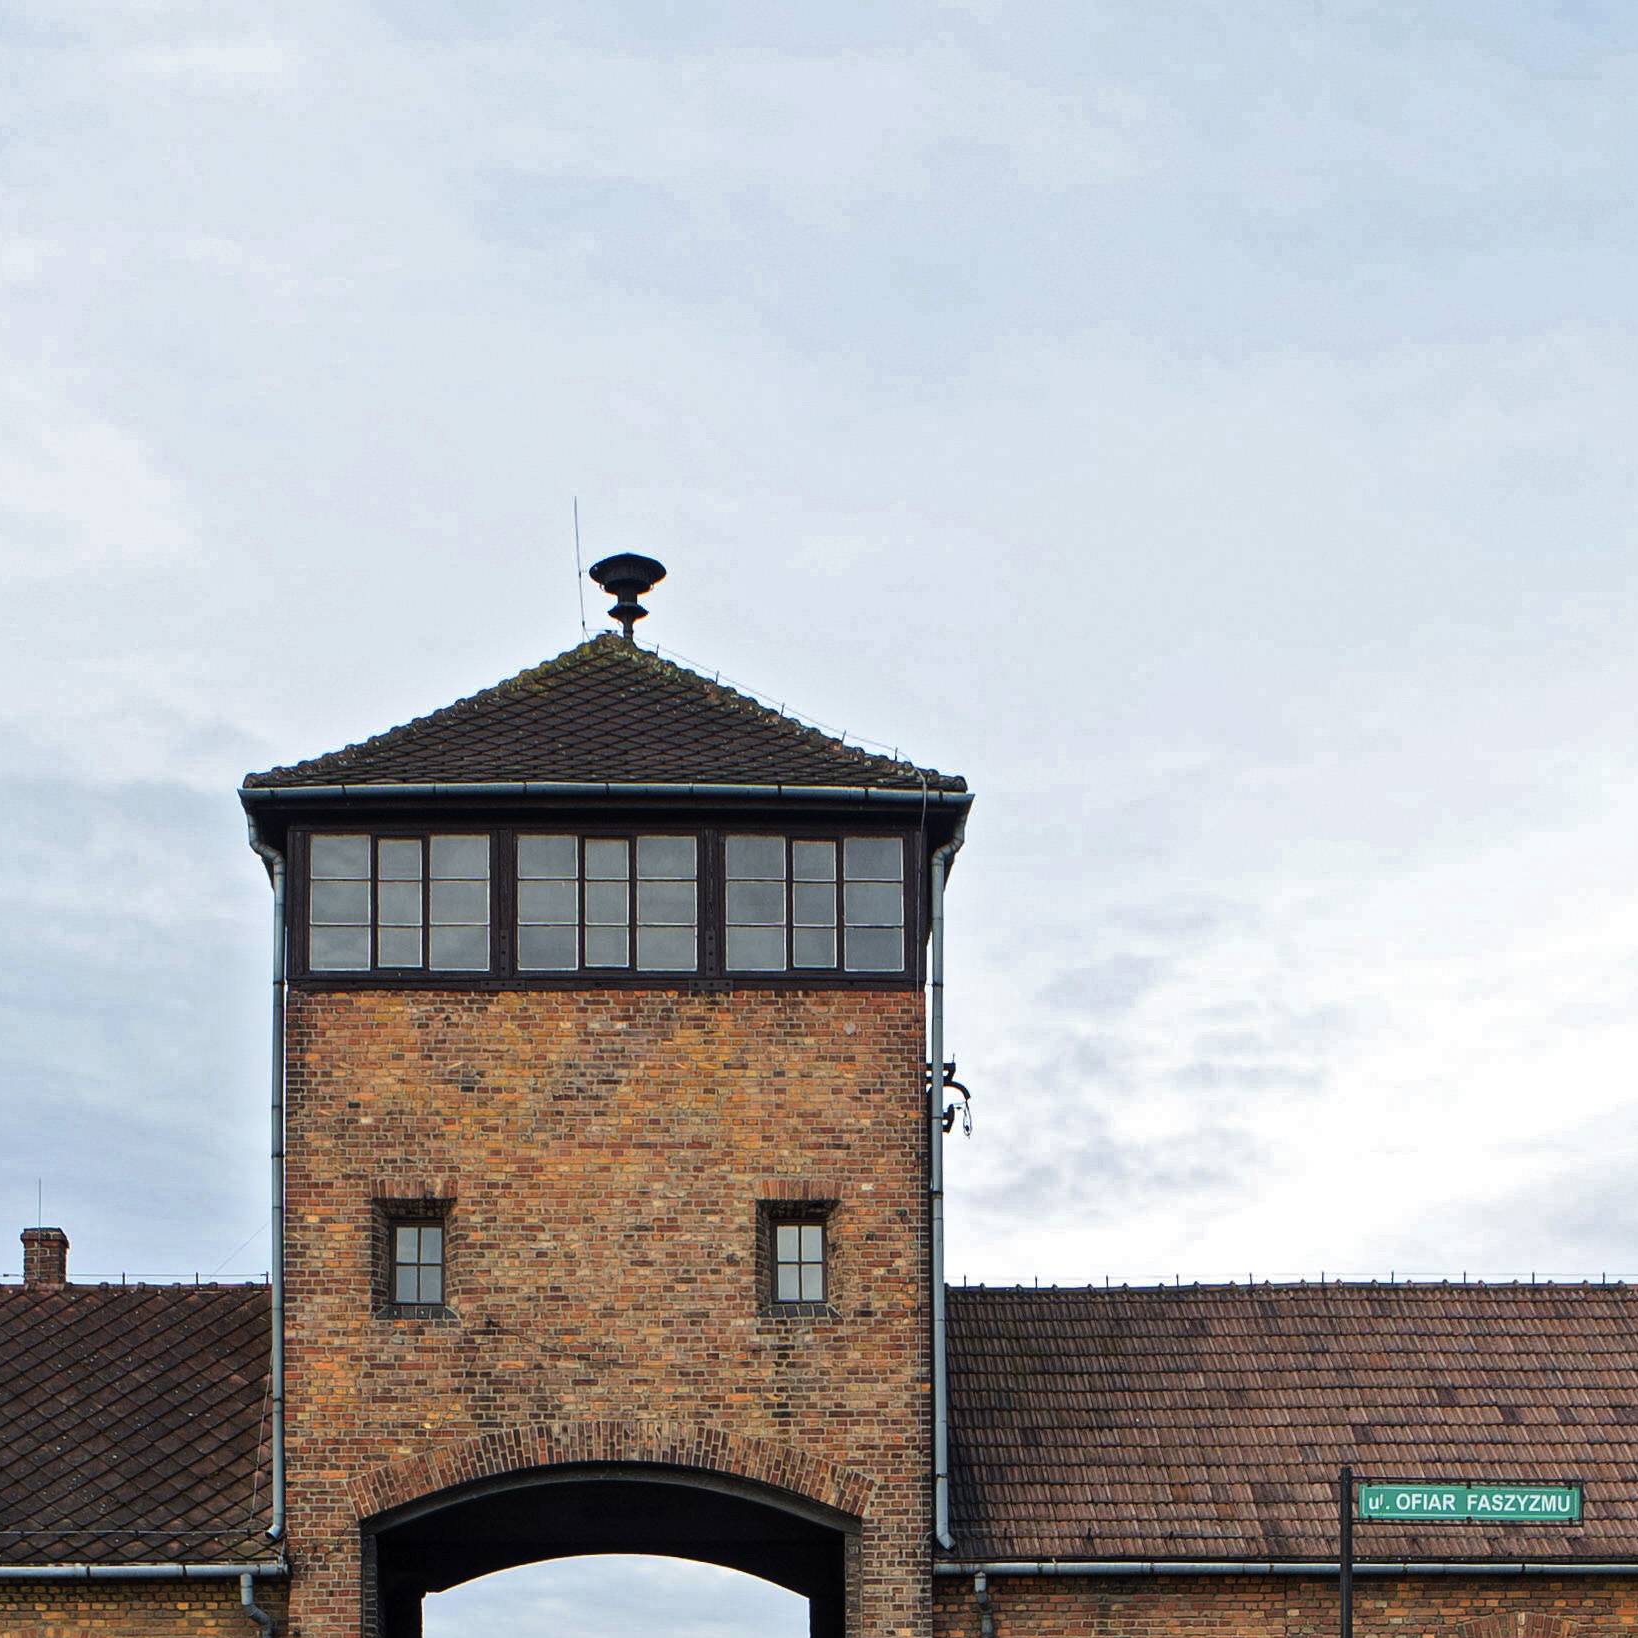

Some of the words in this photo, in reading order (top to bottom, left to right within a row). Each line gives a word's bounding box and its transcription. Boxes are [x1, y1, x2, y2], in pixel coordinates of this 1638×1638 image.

[1368, 1493, 1391, 1510] ul.
[1395, 1493, 1456, 1511] OFIAR
[1467, 1494, 1571, 1512] FASZYZMU
